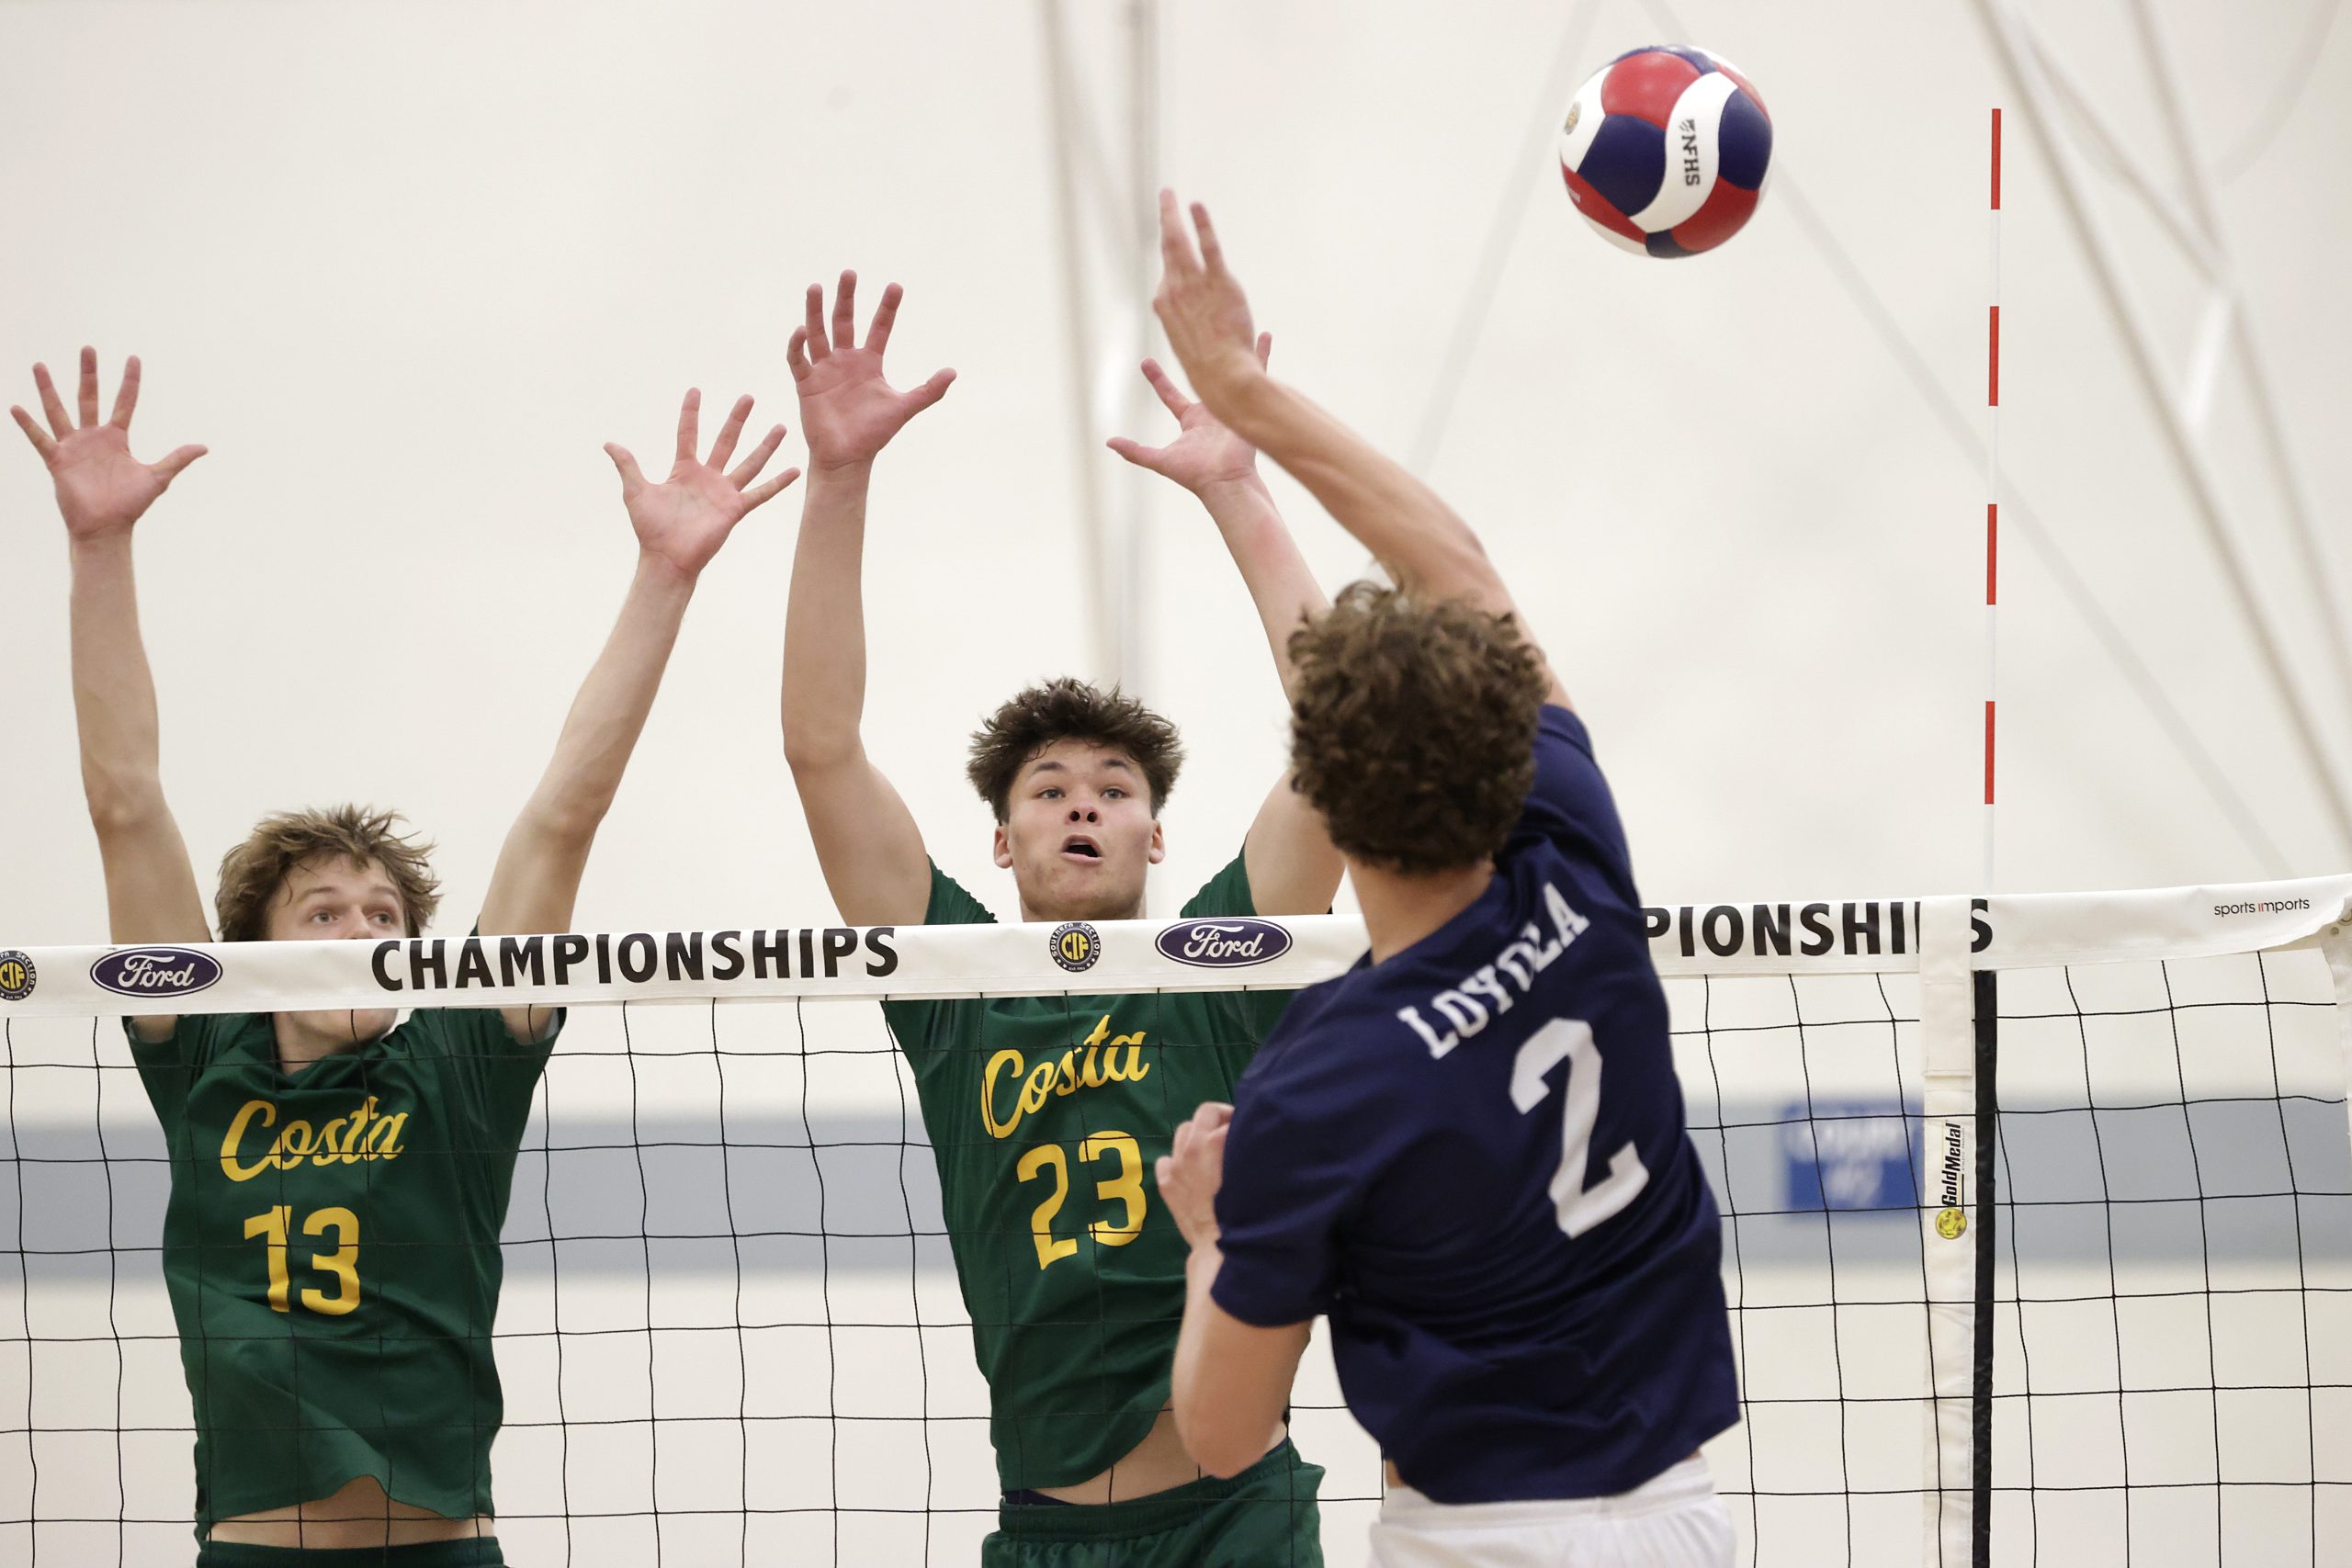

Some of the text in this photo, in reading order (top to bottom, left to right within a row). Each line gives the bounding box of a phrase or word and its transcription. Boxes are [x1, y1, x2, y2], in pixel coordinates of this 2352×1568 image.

[1681, 135, 1701, 186] NFHS
[1185, 922, 1264, 959] Ford
[1643, 898, 1993, 957] PIONSHIS
[2214, 902, 2256, 918] sports
[0, 962, 25, 989] CIF
[118, 953, 194, 989] Ford
[371, 926, 899, 991] CHAMPIONSHIPS
[1061, 932, 1089, 960] CIF
[1396, 882, 1590, 1059] LOYOLA
[980, 1014, 1149, 1138] Costa
[220, 1096, 409, 1181] Costa
[1509, 1018, 1649, 1239] 2
[1016, 1130, 1147, 1270] 23
[244, 1205, 360, 1315] 13
